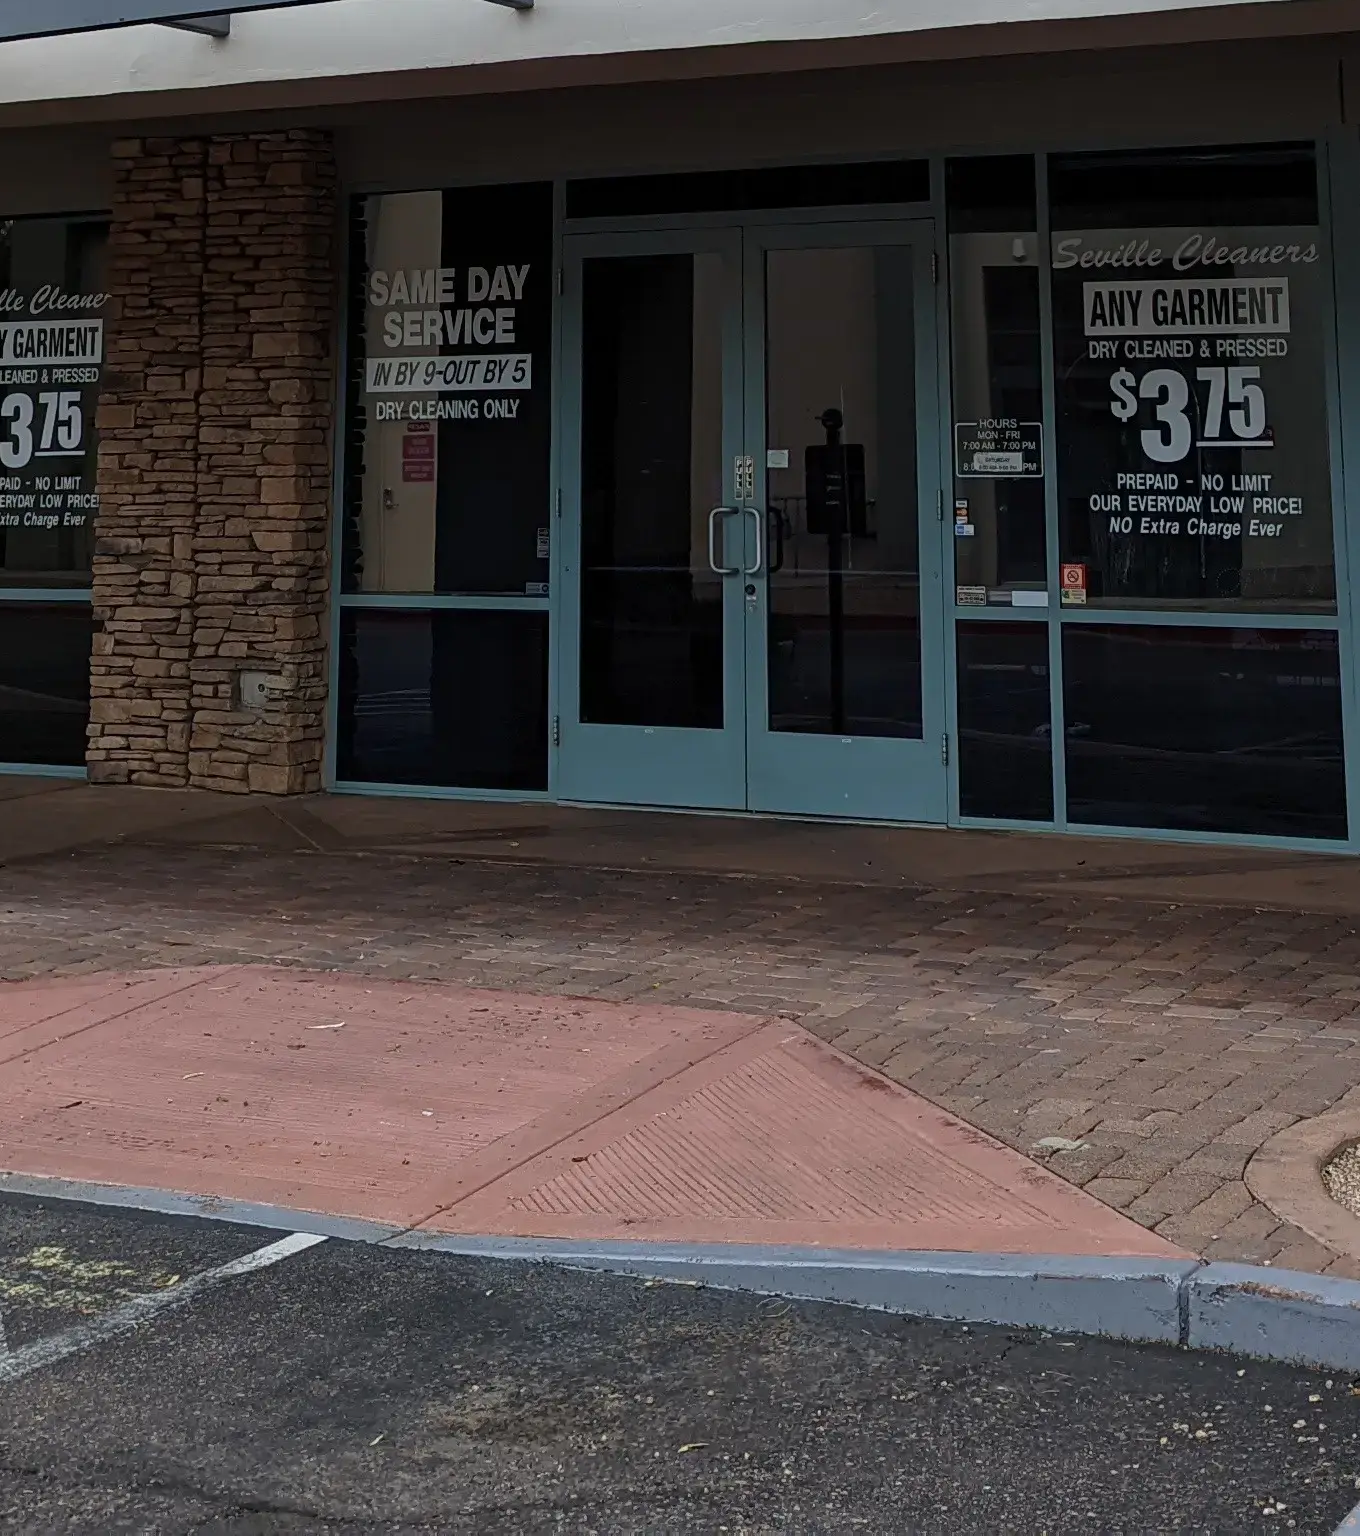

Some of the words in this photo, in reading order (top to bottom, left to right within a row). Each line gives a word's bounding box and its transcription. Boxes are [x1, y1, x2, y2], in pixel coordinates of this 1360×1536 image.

[1051, 237, 1164, 270] Seville
[1172, 233, 1320, 271] Cleaners
[369, 267, 456, 306] SAME
[467, 264, 531, 302] DAY
[29, 284, 113, 315] Cleaner
[1090, 288, 1143, 327] ANY
[1152, 286, 1283, 326] GARMENT
[383, 307, 516, 348] SERVICE
[12, 327, 99, 359] GARMENT
[1089, 340, 1120, 359] DRY
[1124, 339, 1194, 358] CLEANED
[1200, 339, 1211, 358] &
[1216, 338, 1288, 357] PRESSED
[41, 368, 49, 384] &
[52, 367, 99, 383] PRESSED
[372, 361, 392, 387] IN
[394, 361, 420, 386] BY
[483, 359, 509, 384] BY
[511, 358, 527, 384] 5
[375, 401, 405, 421] DRY
[409, 399, 480, 420] CLEANING
[484, 398, 521, 419] ONLY
[979, 418, 1018, 429] HOURS
[977, 430, 998, 440] MON
[1005, 430, 1020, 440] FRI
[962, 441, 981, 450] 7:00
[981, 441, 996, 450] AM
[1002, 441, 1020, 450] 7:00
[1021, 441, 1036, 451] PM
[1022, 462, 1037, 472] PM
[35, 477, 50, 491] NO
[55, 476, 82, 491] LIMIT
[1117, 473, 1179, 490] PREPAID
[1201, 474, 1224, 491] NO
[1232, 474, 1272, 492] LIMIT
[40, 494, 64, 509] LOW
[68, 493, 100, 509] PRICE!
[1090, 494, 1121, 512] OUR
[1129, 495, 1204, 513] EVERYDAY
[1210, 496, 1245, 514] LOW
[1253, 497, 1303, 515] PRICE!
[24, 512, 59, 530] Charge
[63, 512, 86, 526] Ever
[1109, 516, 1133, 534] NO
[1140, 517, 1180, 535] Extra
[1187, 518, 1241, 540] Charge
[1249, 519, 1284, 537] Ever
